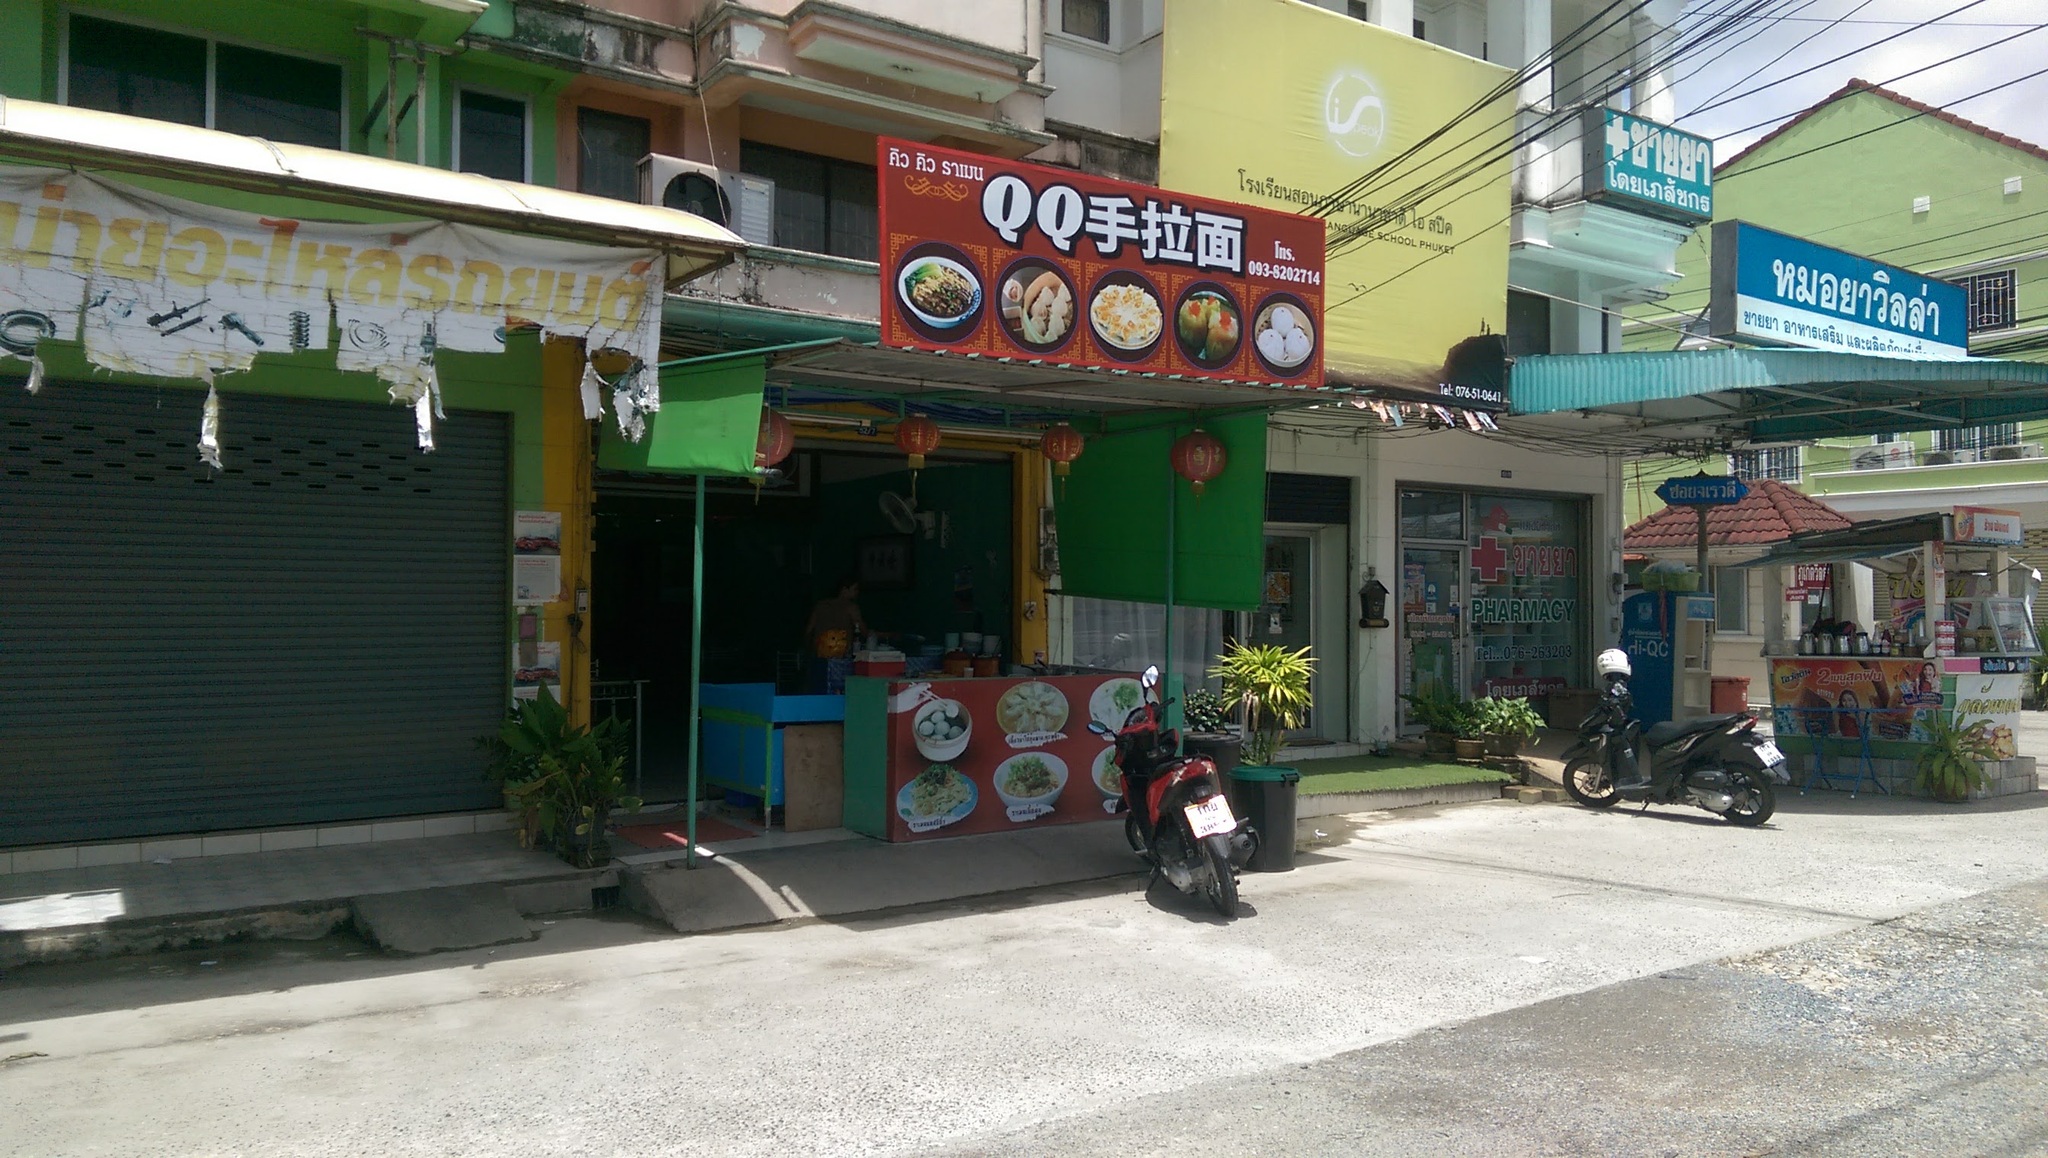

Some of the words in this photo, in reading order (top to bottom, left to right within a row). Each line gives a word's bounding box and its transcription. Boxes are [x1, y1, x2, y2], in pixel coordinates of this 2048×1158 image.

[888, 147, 910, 169] คิว
[915, 152, 937, 174] คิว
[941, 160, 984, 182] ราเมน
[1630, 121, 1711, 187] ขายยา
[1607, 160, 1710, 213] โดยเภสัชกร
[981, 173, 1244, 274] QQ手拉面
[1273, 240, 1297, 262] โทร.
[1377, 230, 1418, 248] SCHOOL
[1418, 240, 1456, 256] PHUKET
[1248, 260, 1321, 287] 093-8202714
[1771, 257, 1942, 338] หมอยาวิลล่า
[1743, 309, 1780, 333] ขายยา
[1783, 319, 1845, 347] อาหารเสริม
[1455, 385, 1502, 403] 076-51-0641
[1513, 544, 1577, 577] ขายยา
[1470, 597, 1576, 623] PHARMACY
